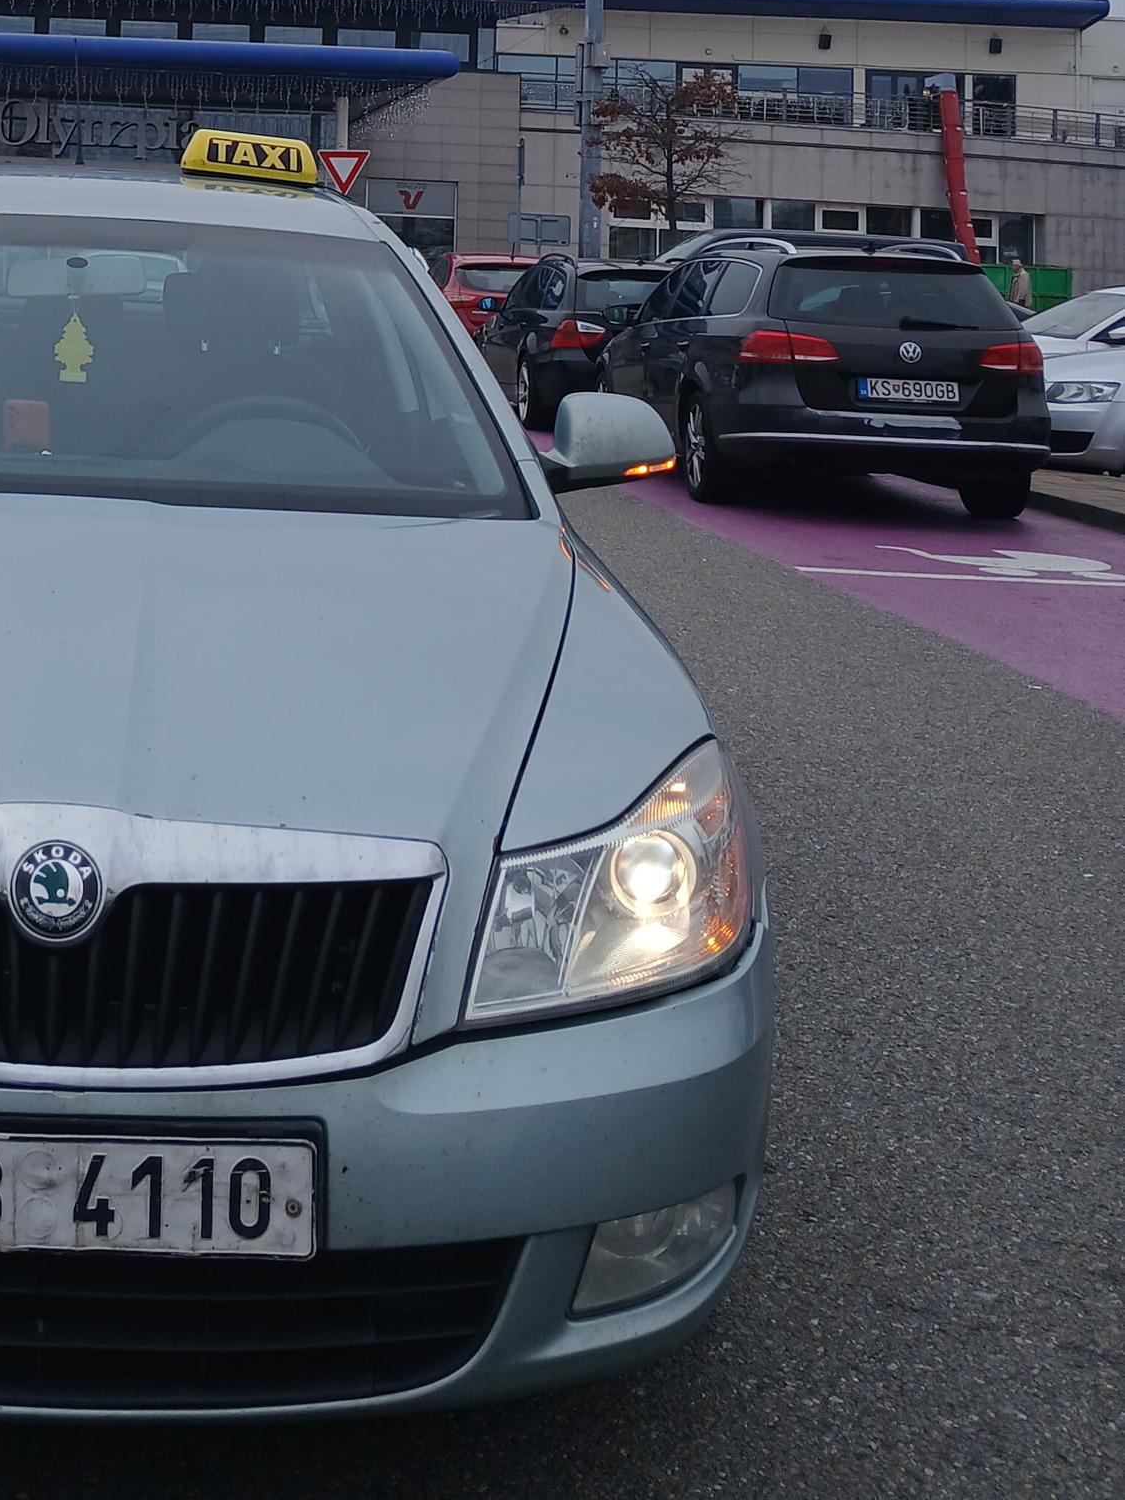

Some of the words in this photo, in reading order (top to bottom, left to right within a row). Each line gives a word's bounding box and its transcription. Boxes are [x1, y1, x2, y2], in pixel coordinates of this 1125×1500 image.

[212, 140, 298, 172] TAXI
[870, 380, 892, 397] KS
[901, 382, 956, 400] 690GB
[73, 1152, 272, 1240] 4110
